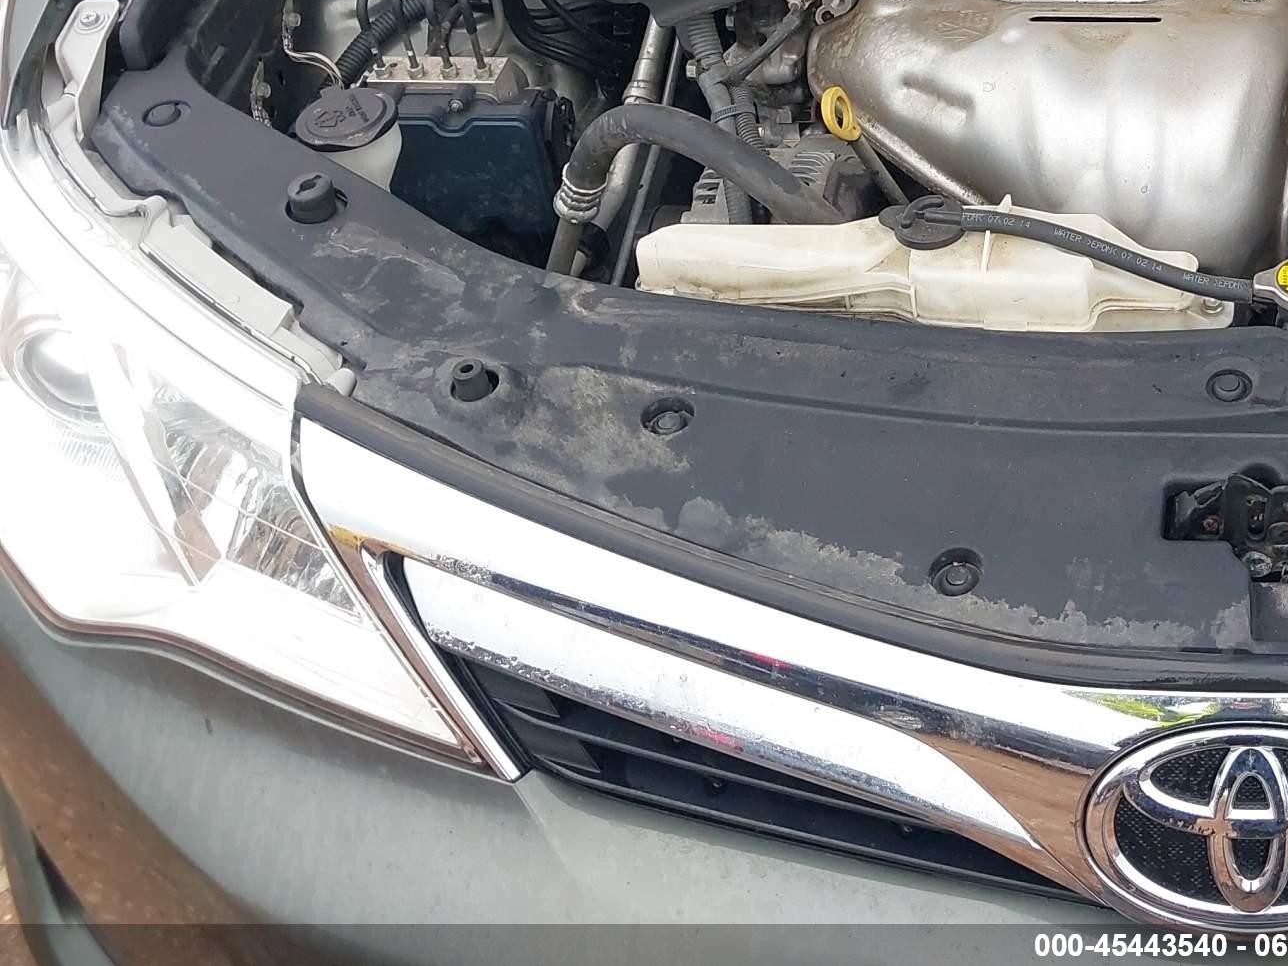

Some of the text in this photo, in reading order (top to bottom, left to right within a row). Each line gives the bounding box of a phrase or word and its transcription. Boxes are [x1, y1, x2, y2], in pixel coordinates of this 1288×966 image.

[1003, 218, 1015, 227] 02
[1054, 227, 1082, 244] WATER
[1121, 251, 1133, 261] 07
[1136, 257, 1147, 268] 02
[1151, 262, 1162, 273] 14
[1183, 272, 1210, 286] WATER
